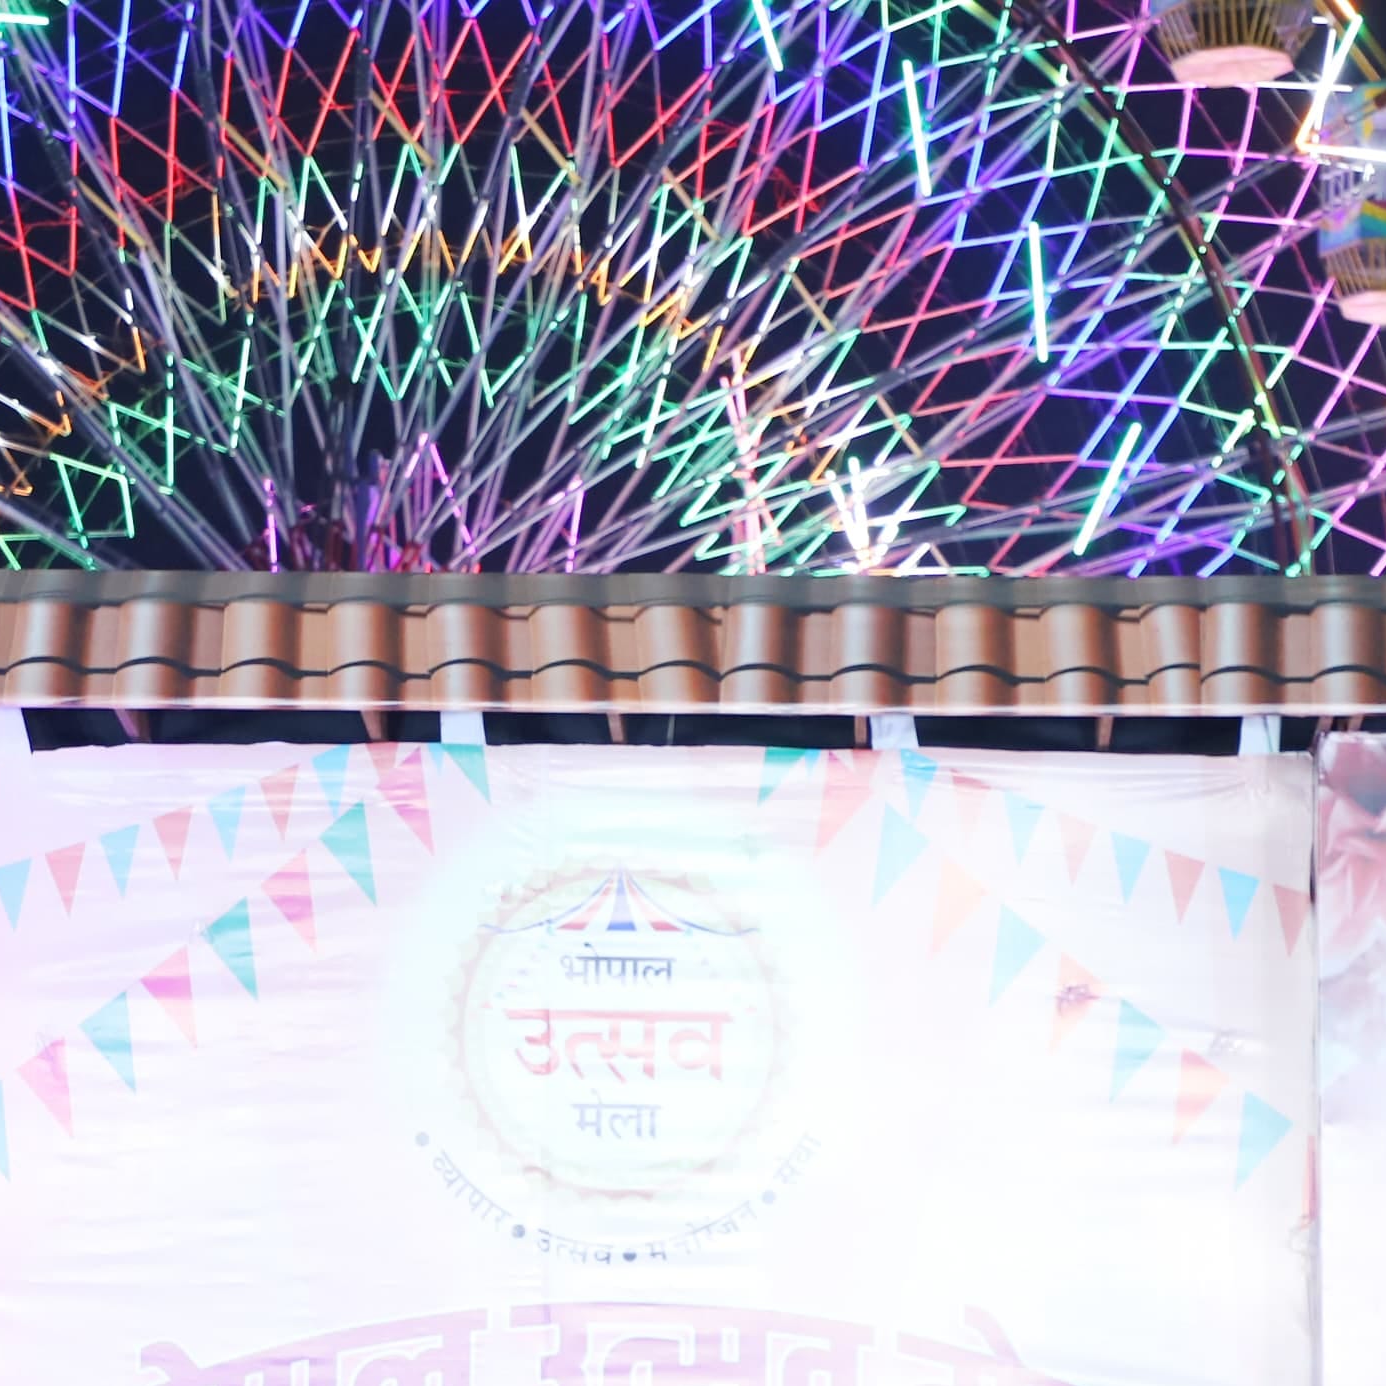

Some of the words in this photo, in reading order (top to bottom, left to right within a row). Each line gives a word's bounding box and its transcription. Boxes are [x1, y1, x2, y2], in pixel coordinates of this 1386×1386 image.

[560, 942, 676, 985] भोपाल
[505, 1008, 735, 1084] उत्सव
[572, 1088, 661, 1140] मेला
[430, 1149, 512, 1228] व्यापार
